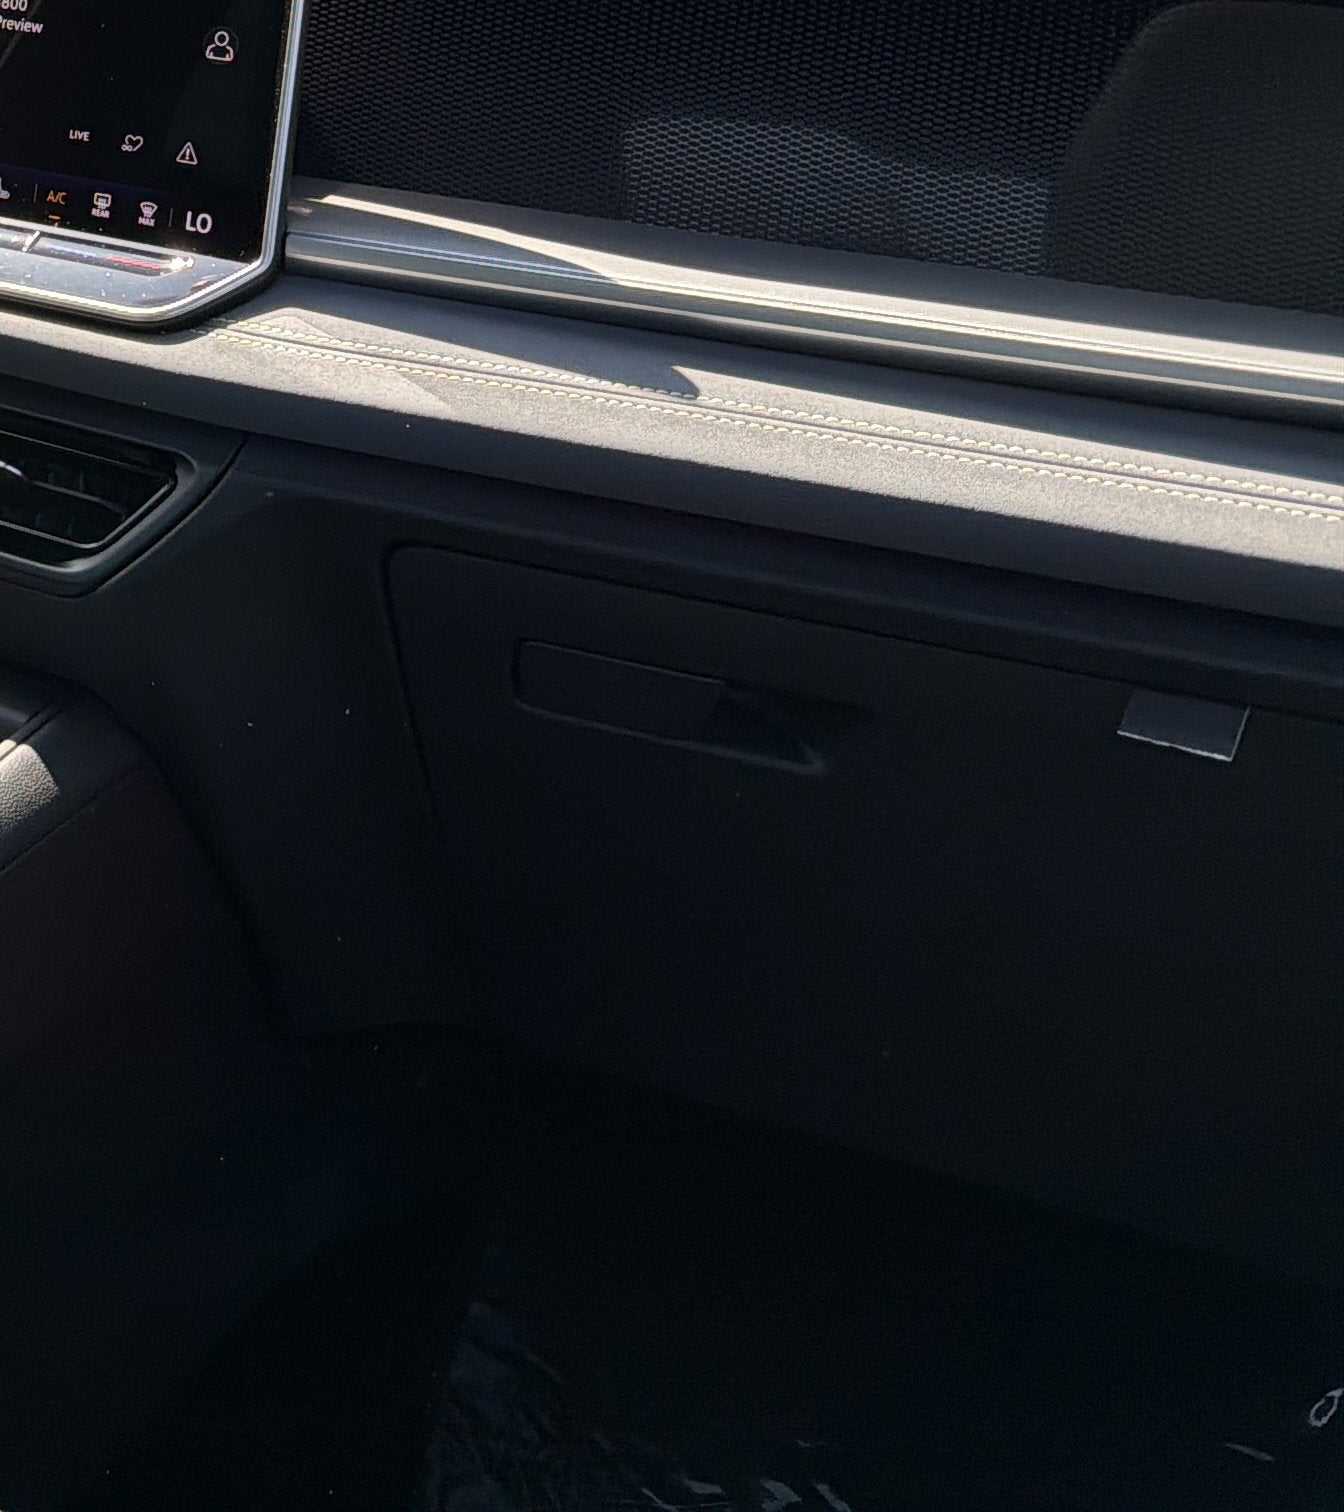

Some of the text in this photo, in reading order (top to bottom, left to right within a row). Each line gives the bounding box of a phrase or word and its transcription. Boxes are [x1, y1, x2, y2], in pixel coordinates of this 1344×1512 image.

[69, 129, 91, 142] LIVE
[46, 189, 68, 205] A/C
[185, 210, 213, 234] LO
